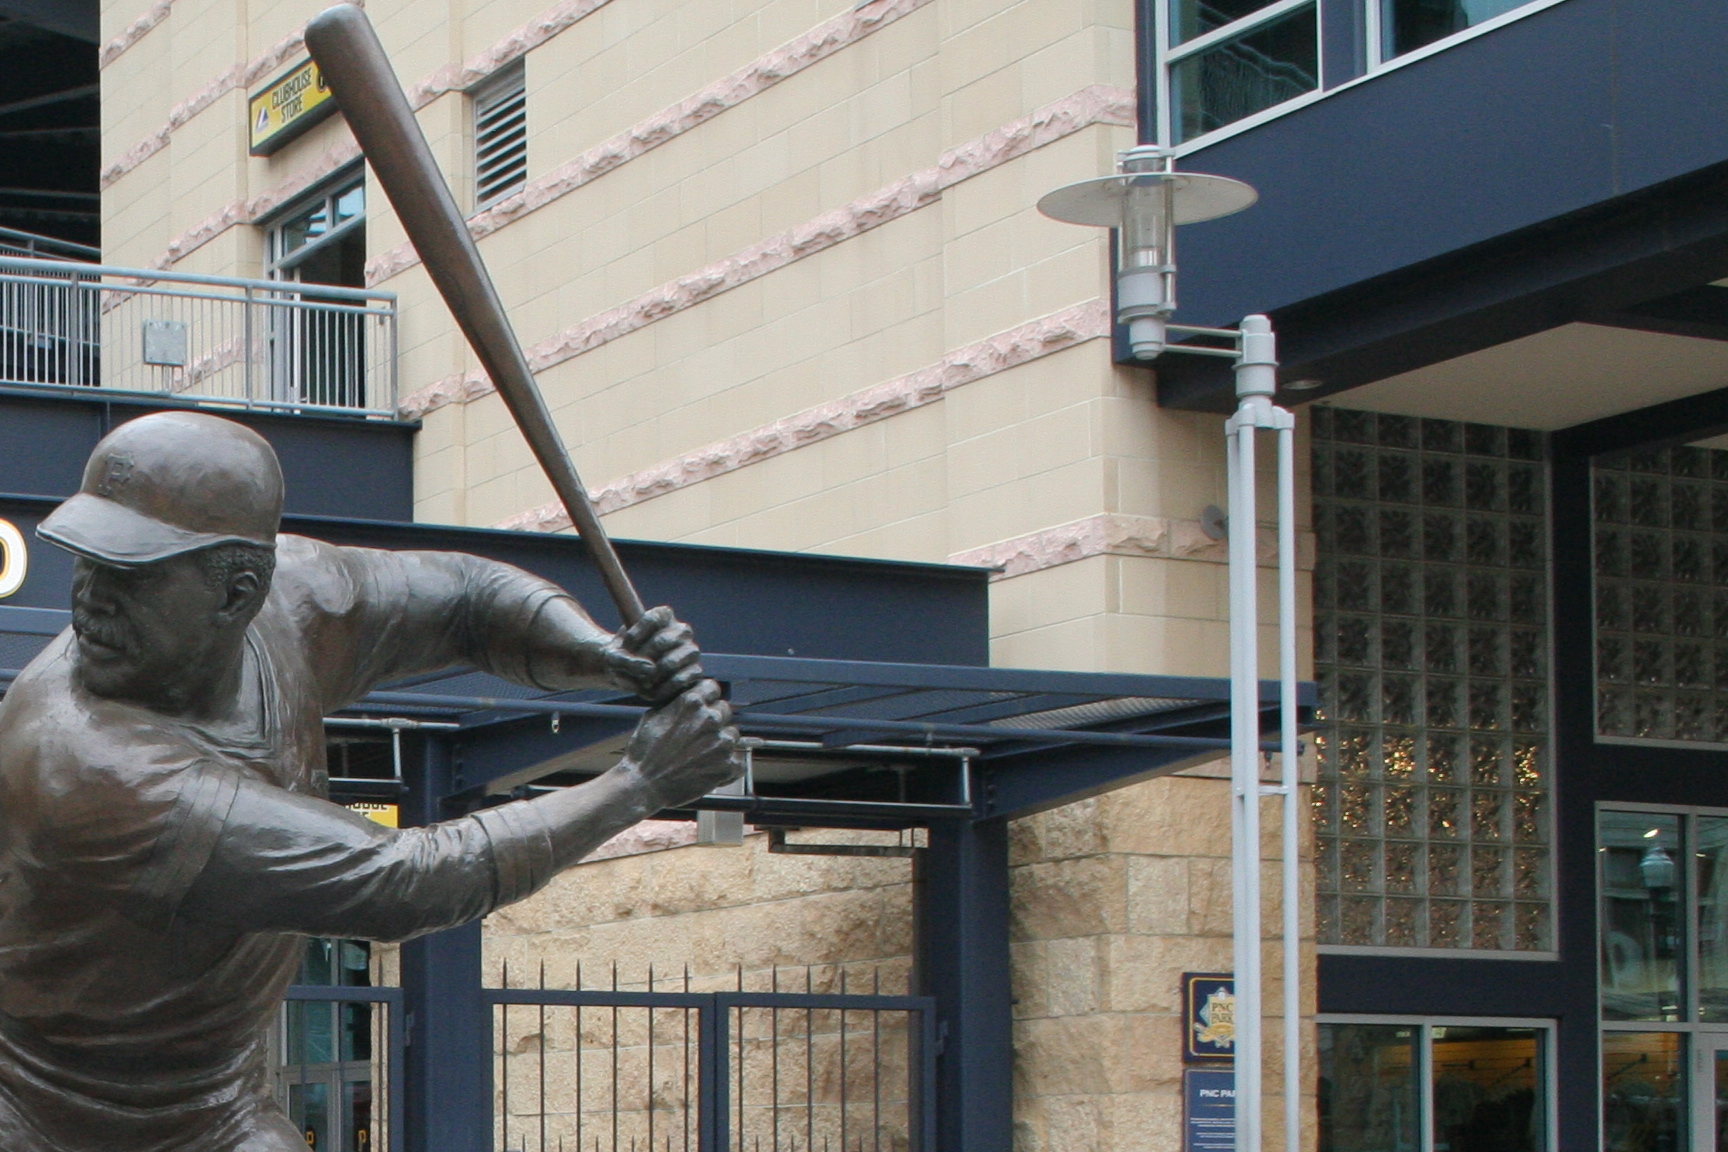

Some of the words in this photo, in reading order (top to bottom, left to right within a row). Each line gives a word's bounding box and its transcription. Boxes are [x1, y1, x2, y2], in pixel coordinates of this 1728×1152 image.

[272, 67, 312, 110] CLUBHOUSE
[281, 93, 303, 124] STORE
[1200, 1089, 1220, 1097] PNC
